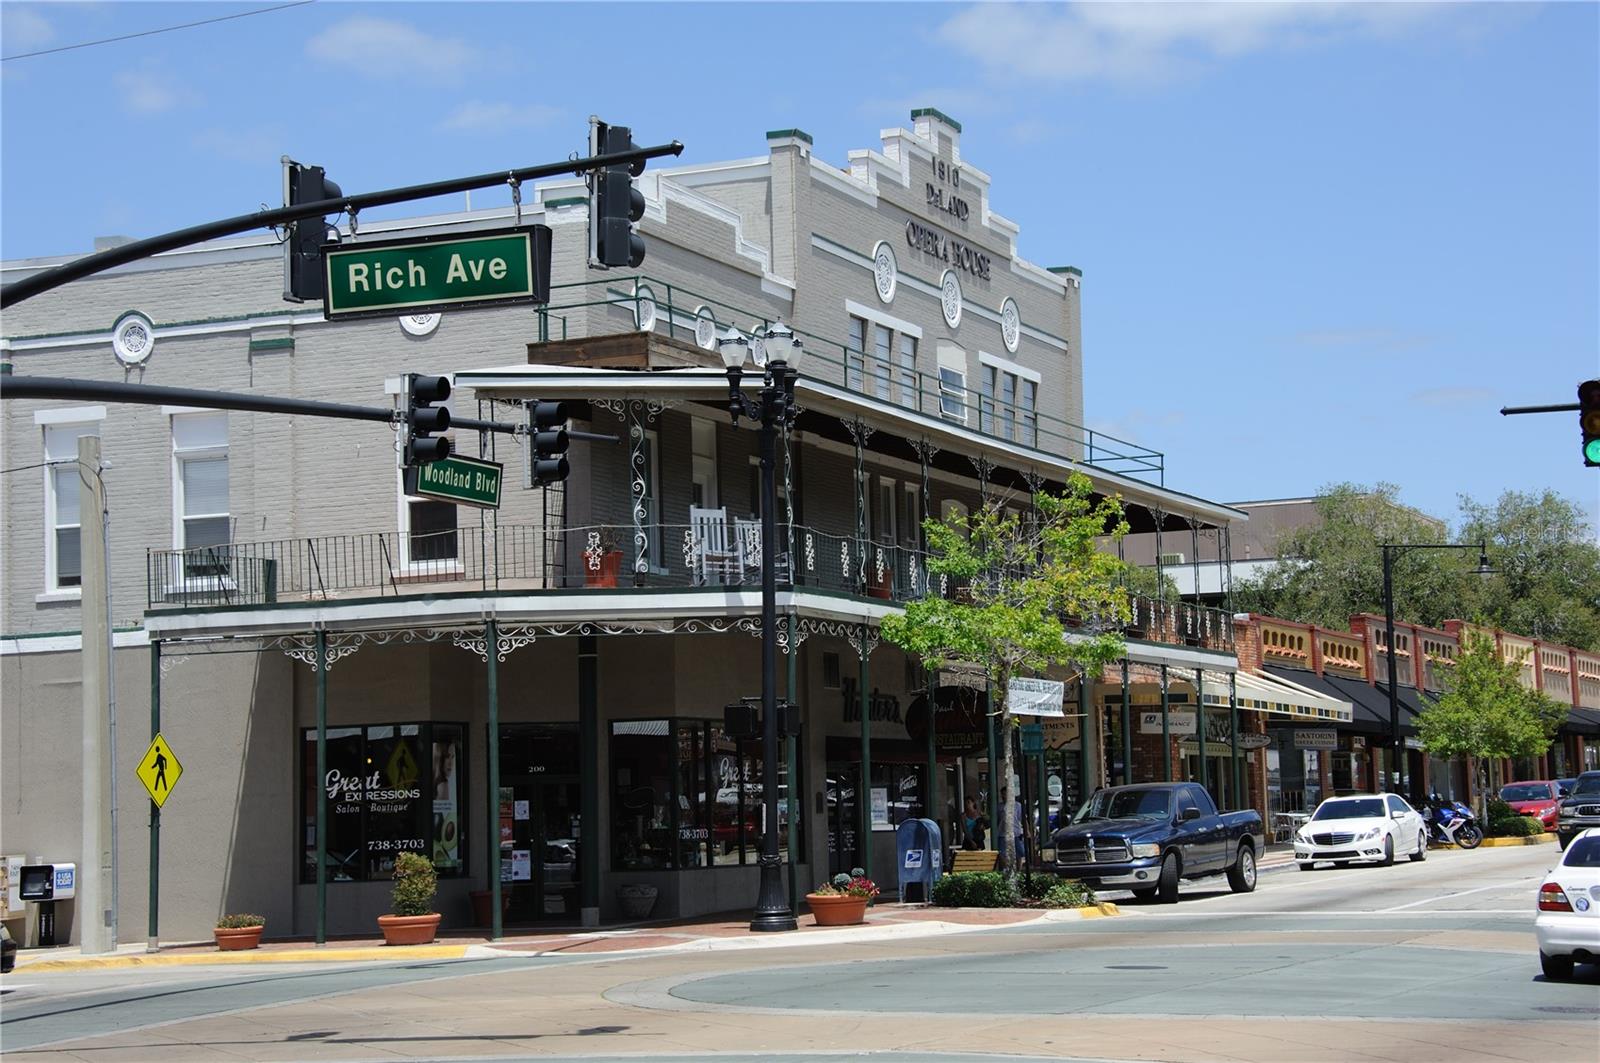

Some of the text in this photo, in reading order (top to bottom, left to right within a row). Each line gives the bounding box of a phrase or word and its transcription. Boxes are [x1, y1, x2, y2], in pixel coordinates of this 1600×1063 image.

[906, 218, 991, 281] OPERA HOUSE
[348, 253, 507, 293] Rich Ave
[424, 463, 497, 493] Woodland Blvd
[935, 732, 984, 745] STAURANT
[1295, 732, 1335, 740] SANTORINI
[528, 765, 545, 773] 200
[335, 802, 408, 814] Salon Boutique
[367, 839, 425, 851] 738-3703
